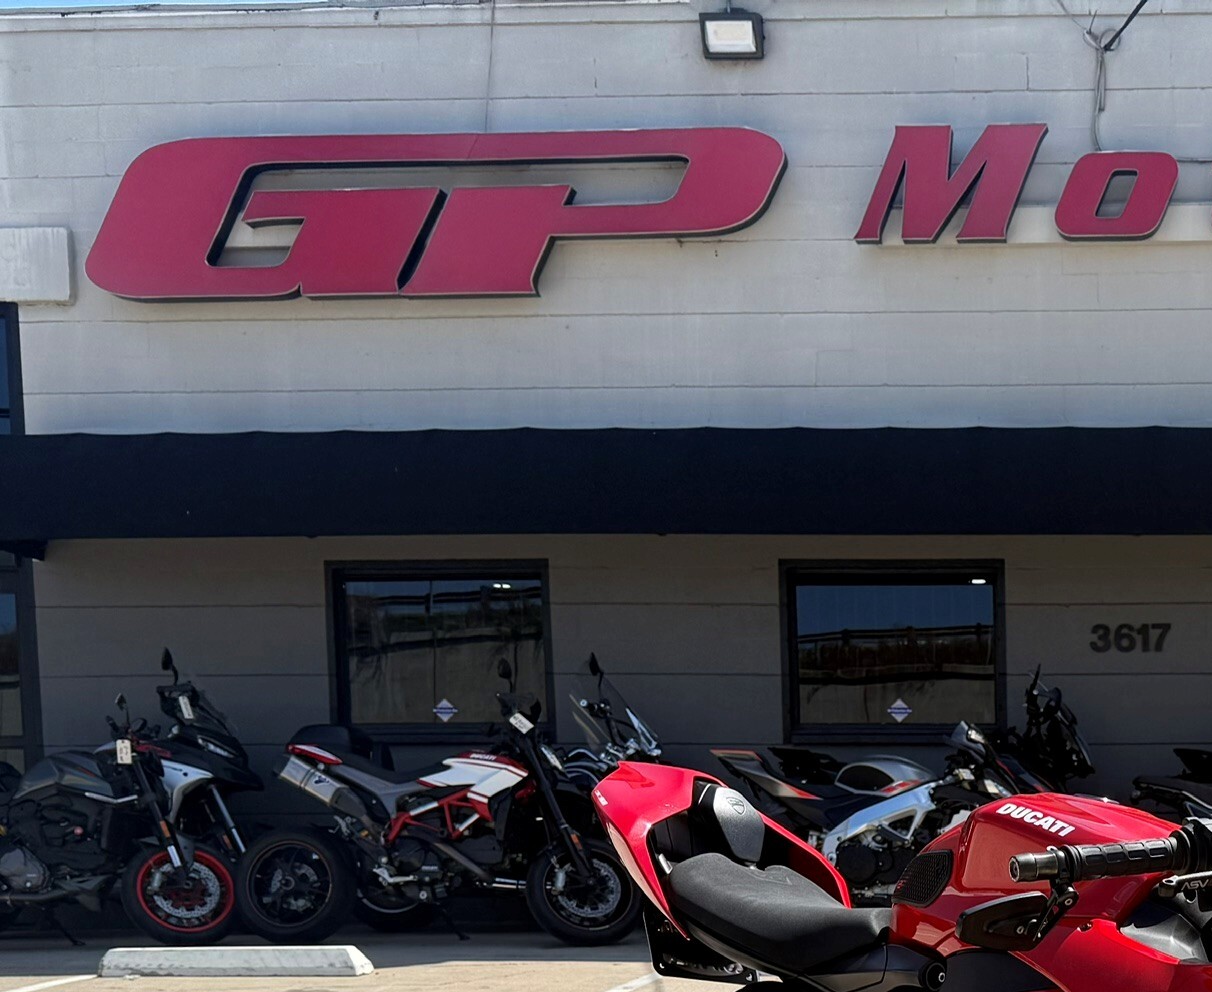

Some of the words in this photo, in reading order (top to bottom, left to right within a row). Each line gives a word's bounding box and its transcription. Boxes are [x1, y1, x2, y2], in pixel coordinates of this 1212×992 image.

[84, 126, 790, 302] GP
[1089, 622, 1172, 653] 3617
[995, 802, 1077, 837] DUCATI
[1181, 879, 1209, 891] ASV
